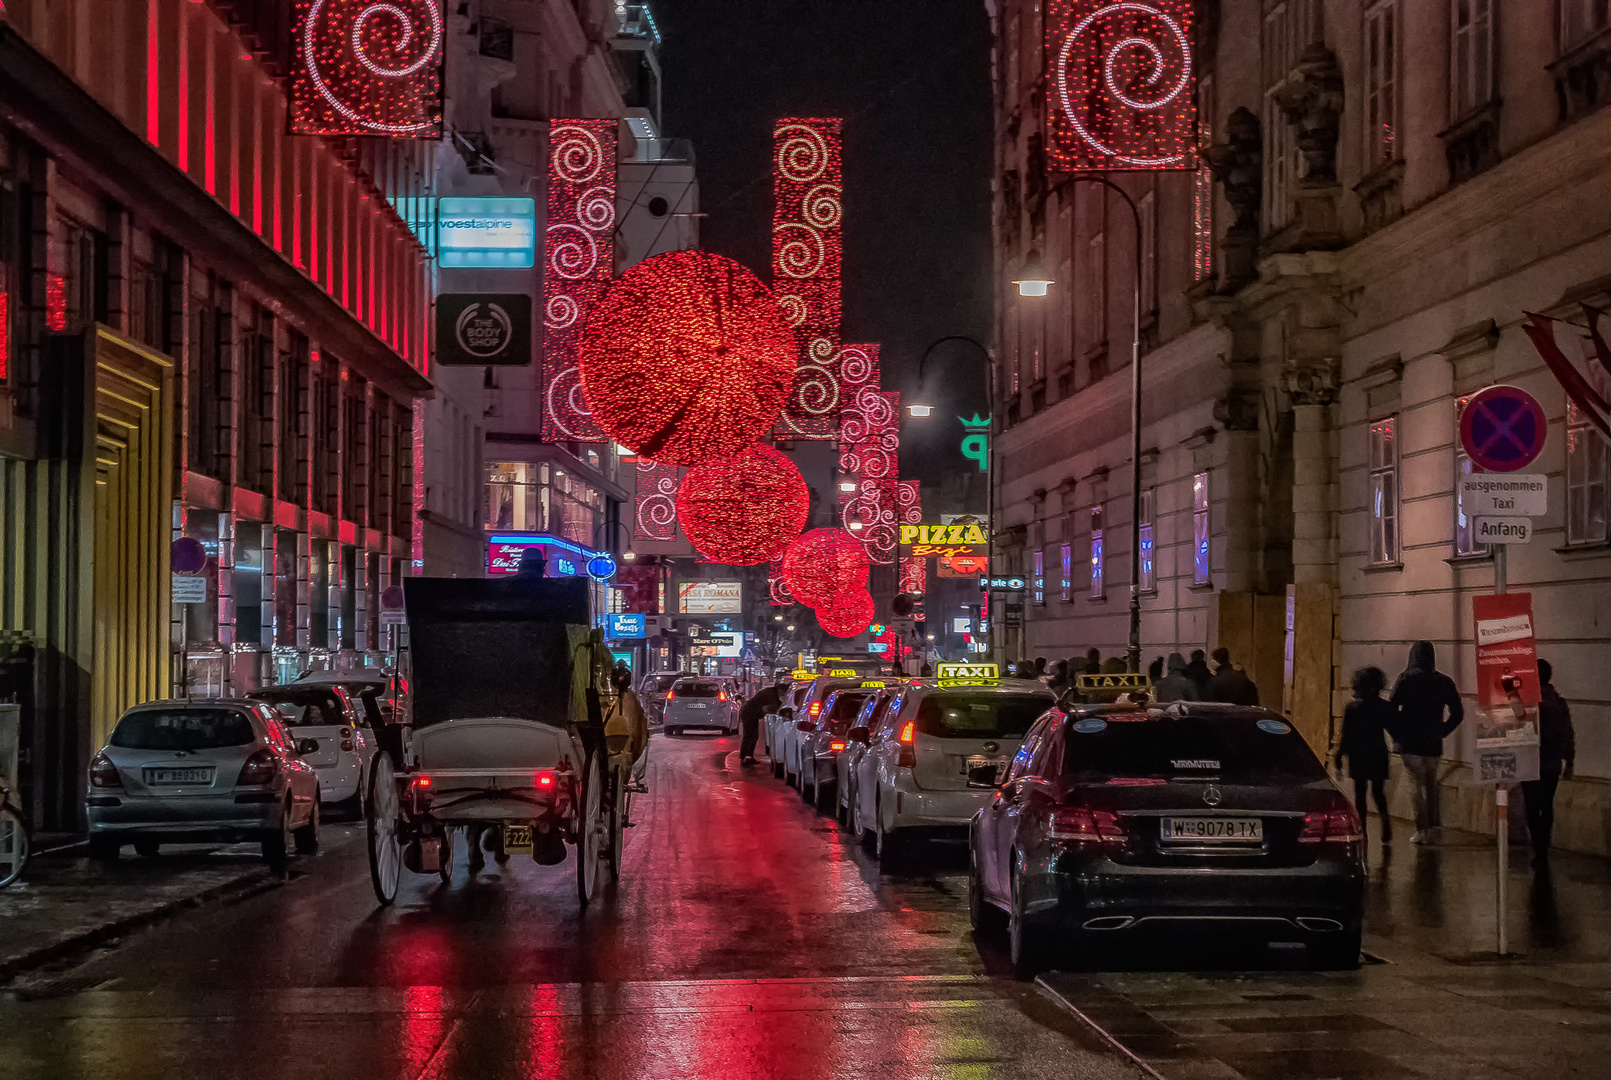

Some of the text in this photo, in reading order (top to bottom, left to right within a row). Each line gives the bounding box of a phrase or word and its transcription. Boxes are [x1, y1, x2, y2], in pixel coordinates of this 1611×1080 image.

[440, 218, 513, 230] voestalpine
[466, 328, 501, 338] BODY
[469, 338, 499, 347] SHOP
[1464, 481, 1543, 493] ausgenommen
[1492, 497, 1515, 509] Taxi
[899, 525, 987, 545] PIZZA
[1481, 522, 1527, 539] Anfang
[703, 589, 740, 597] ROMANA
[945, 667, 990, 677] TAXI
[1090, 675, 1139, 687] TAXI
[1174, 821, 1185, 837] W
[1197, 821, 1235, 837] 9078
[1239, 821, 1258, 837] TX
